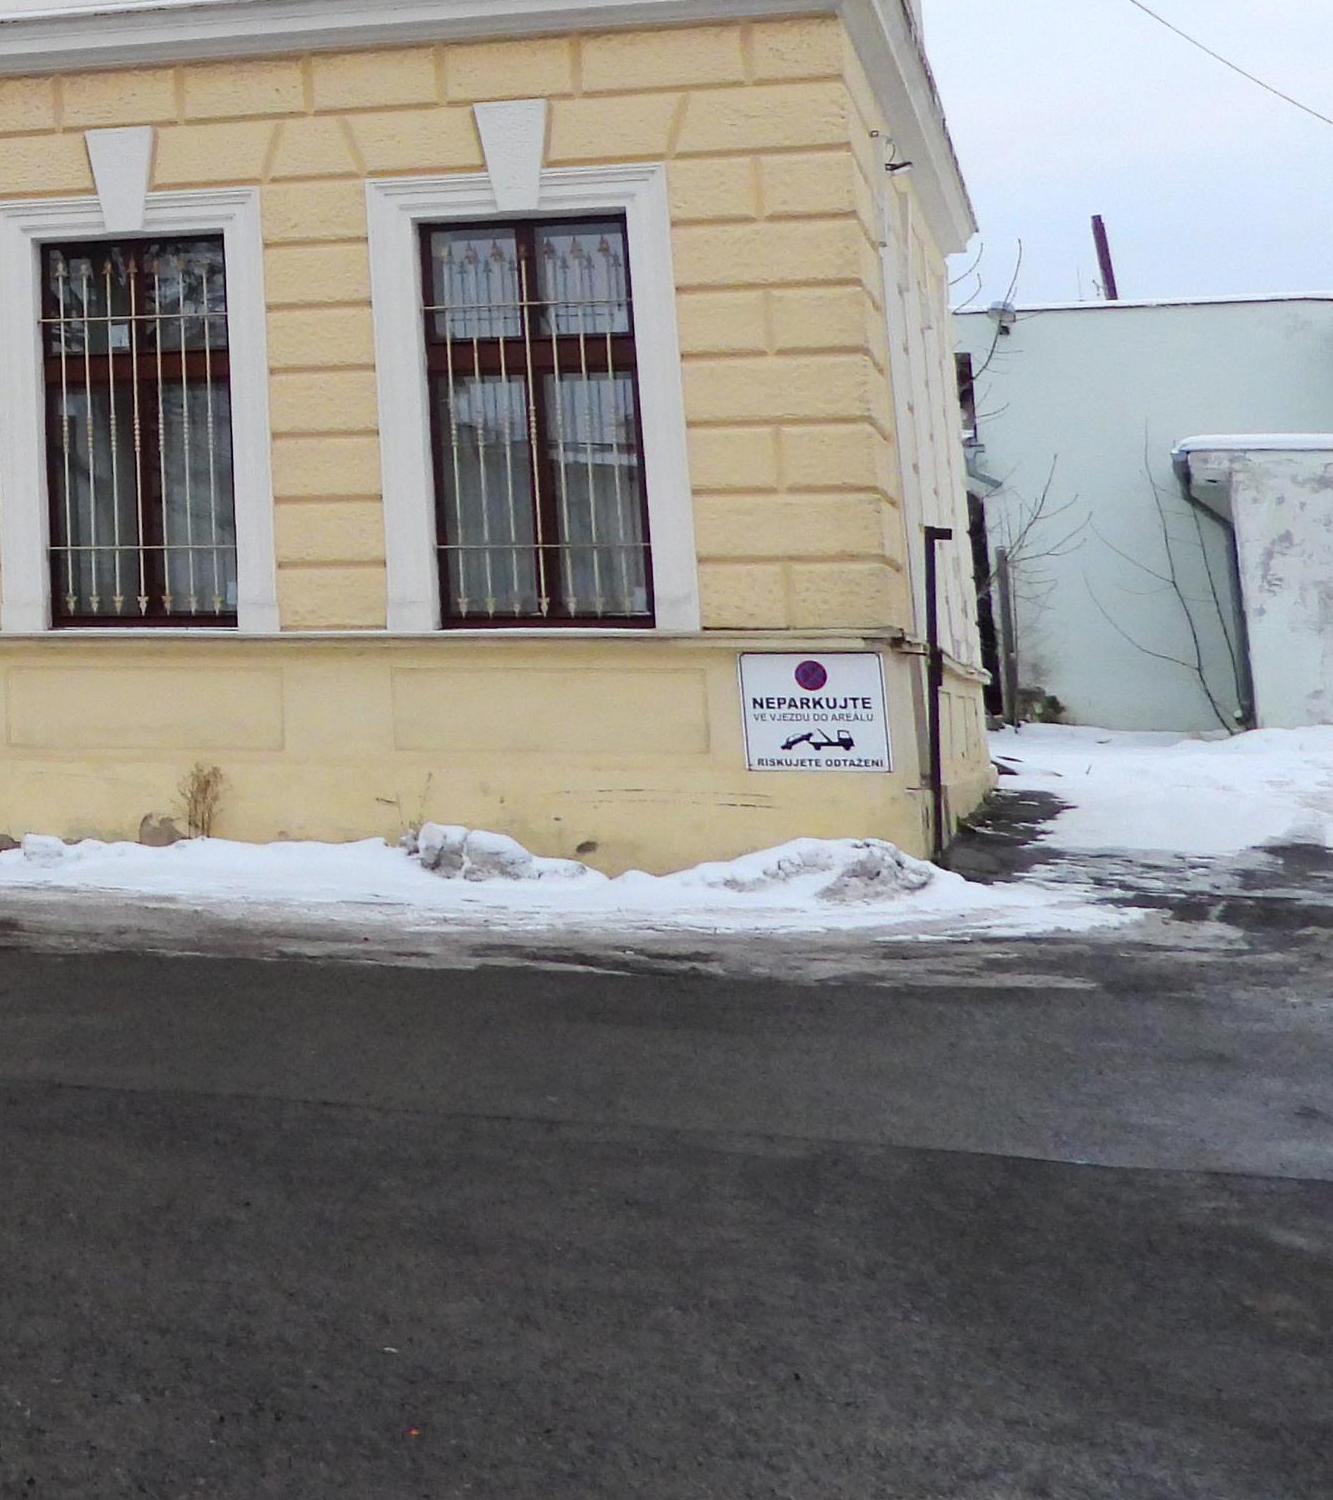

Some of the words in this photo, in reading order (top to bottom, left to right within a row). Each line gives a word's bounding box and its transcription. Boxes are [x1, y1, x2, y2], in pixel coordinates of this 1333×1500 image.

[752, 697, 872, 709] NEPARKUJTE
[753, 713, 766, 721] VE
[769, 713, 810, 721] VJEZDU
[813, 713, 829, 721] DO
[757, 758, 822, 767] RISKUJETE
